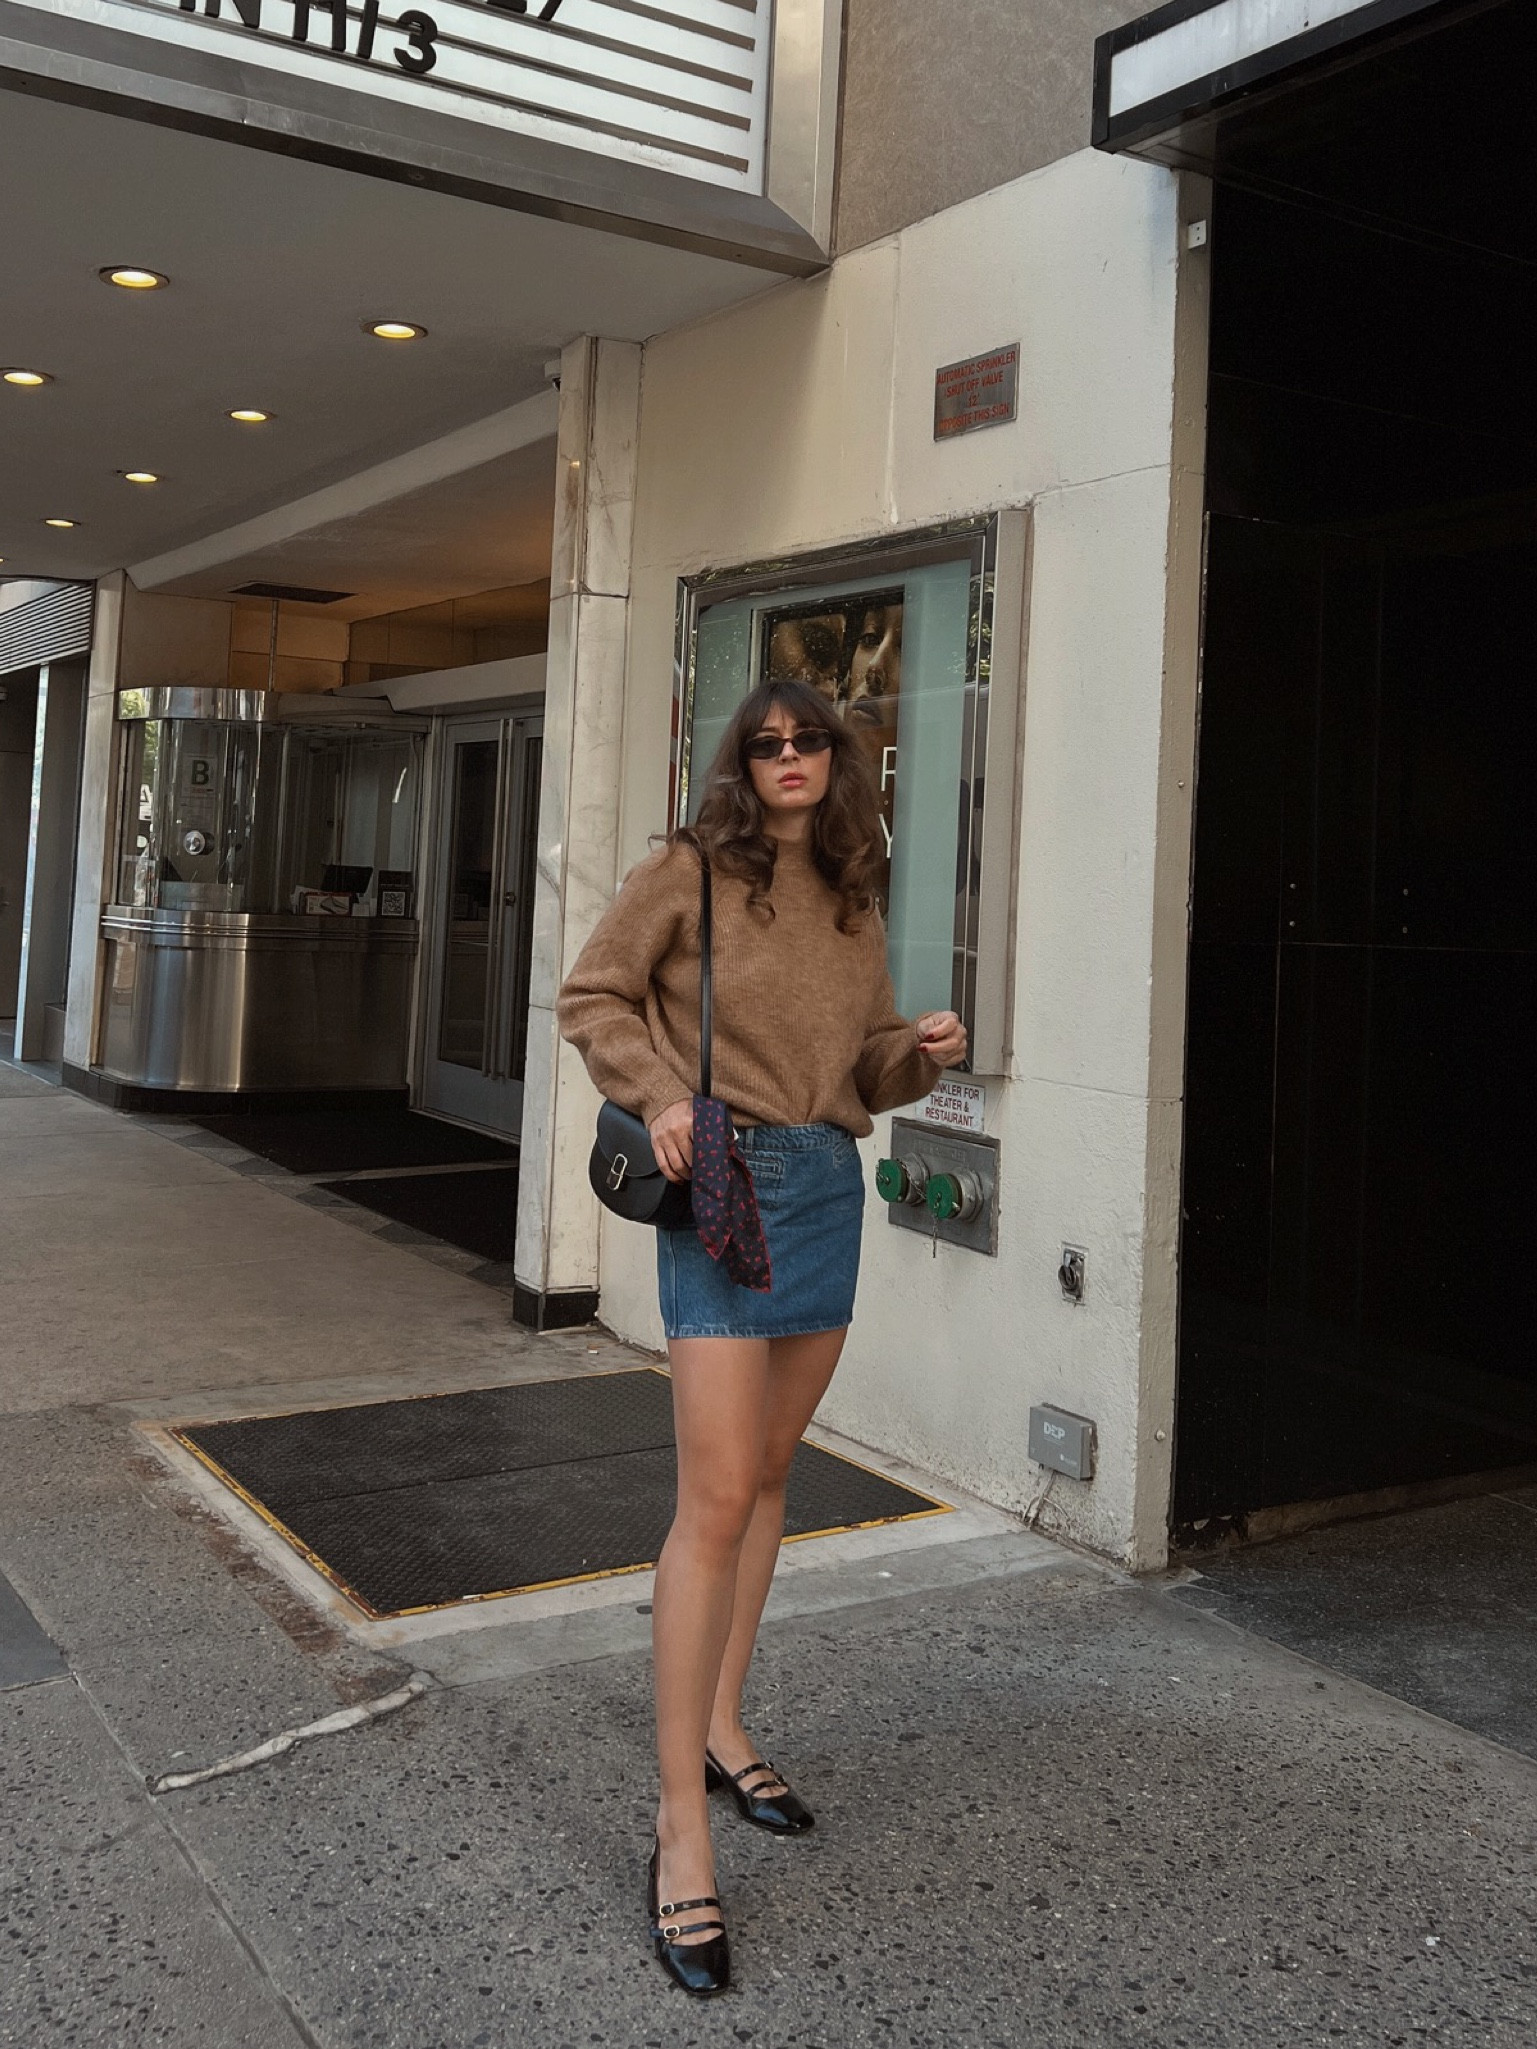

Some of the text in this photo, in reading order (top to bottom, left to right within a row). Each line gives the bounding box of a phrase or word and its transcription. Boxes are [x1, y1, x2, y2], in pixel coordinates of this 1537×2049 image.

[937, 351, 1015, 384] AUTOMATIC SPRINKLER
[946, 371, 1004, 398] SHUT OFF VALVE
[974, 408, 990, 421] THIS
[992, 403, 1009, 418] SIGN
[191, 760, 209, 785] B
[930, 1094, 962, 1110] THEATER
[964, 1087, 980, 1101] FOR
[925, 1107, 974, 1127] RESTAURANT
[1043, 1421, 1065, 1440] DEP
